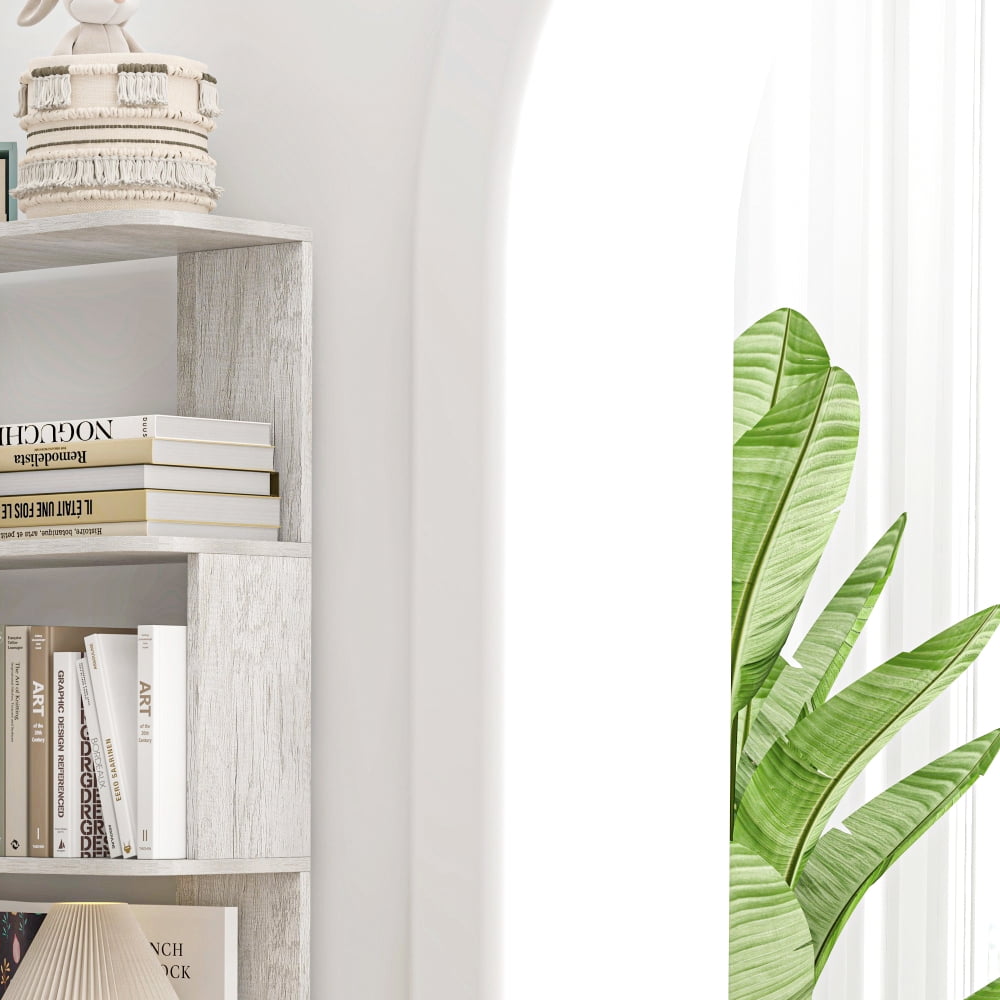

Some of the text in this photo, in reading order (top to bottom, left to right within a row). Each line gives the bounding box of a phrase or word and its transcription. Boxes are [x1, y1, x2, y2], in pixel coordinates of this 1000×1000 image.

[14, 450, 87, 467] Remodelista
[32, 680, 45, 718] ART
[139, 680, 152, 718] ART
[57, 670, 65, 818] GRAPHIC DESIGN REFERENCED
[105, 738, 122, 802] EERO SAARINEN
